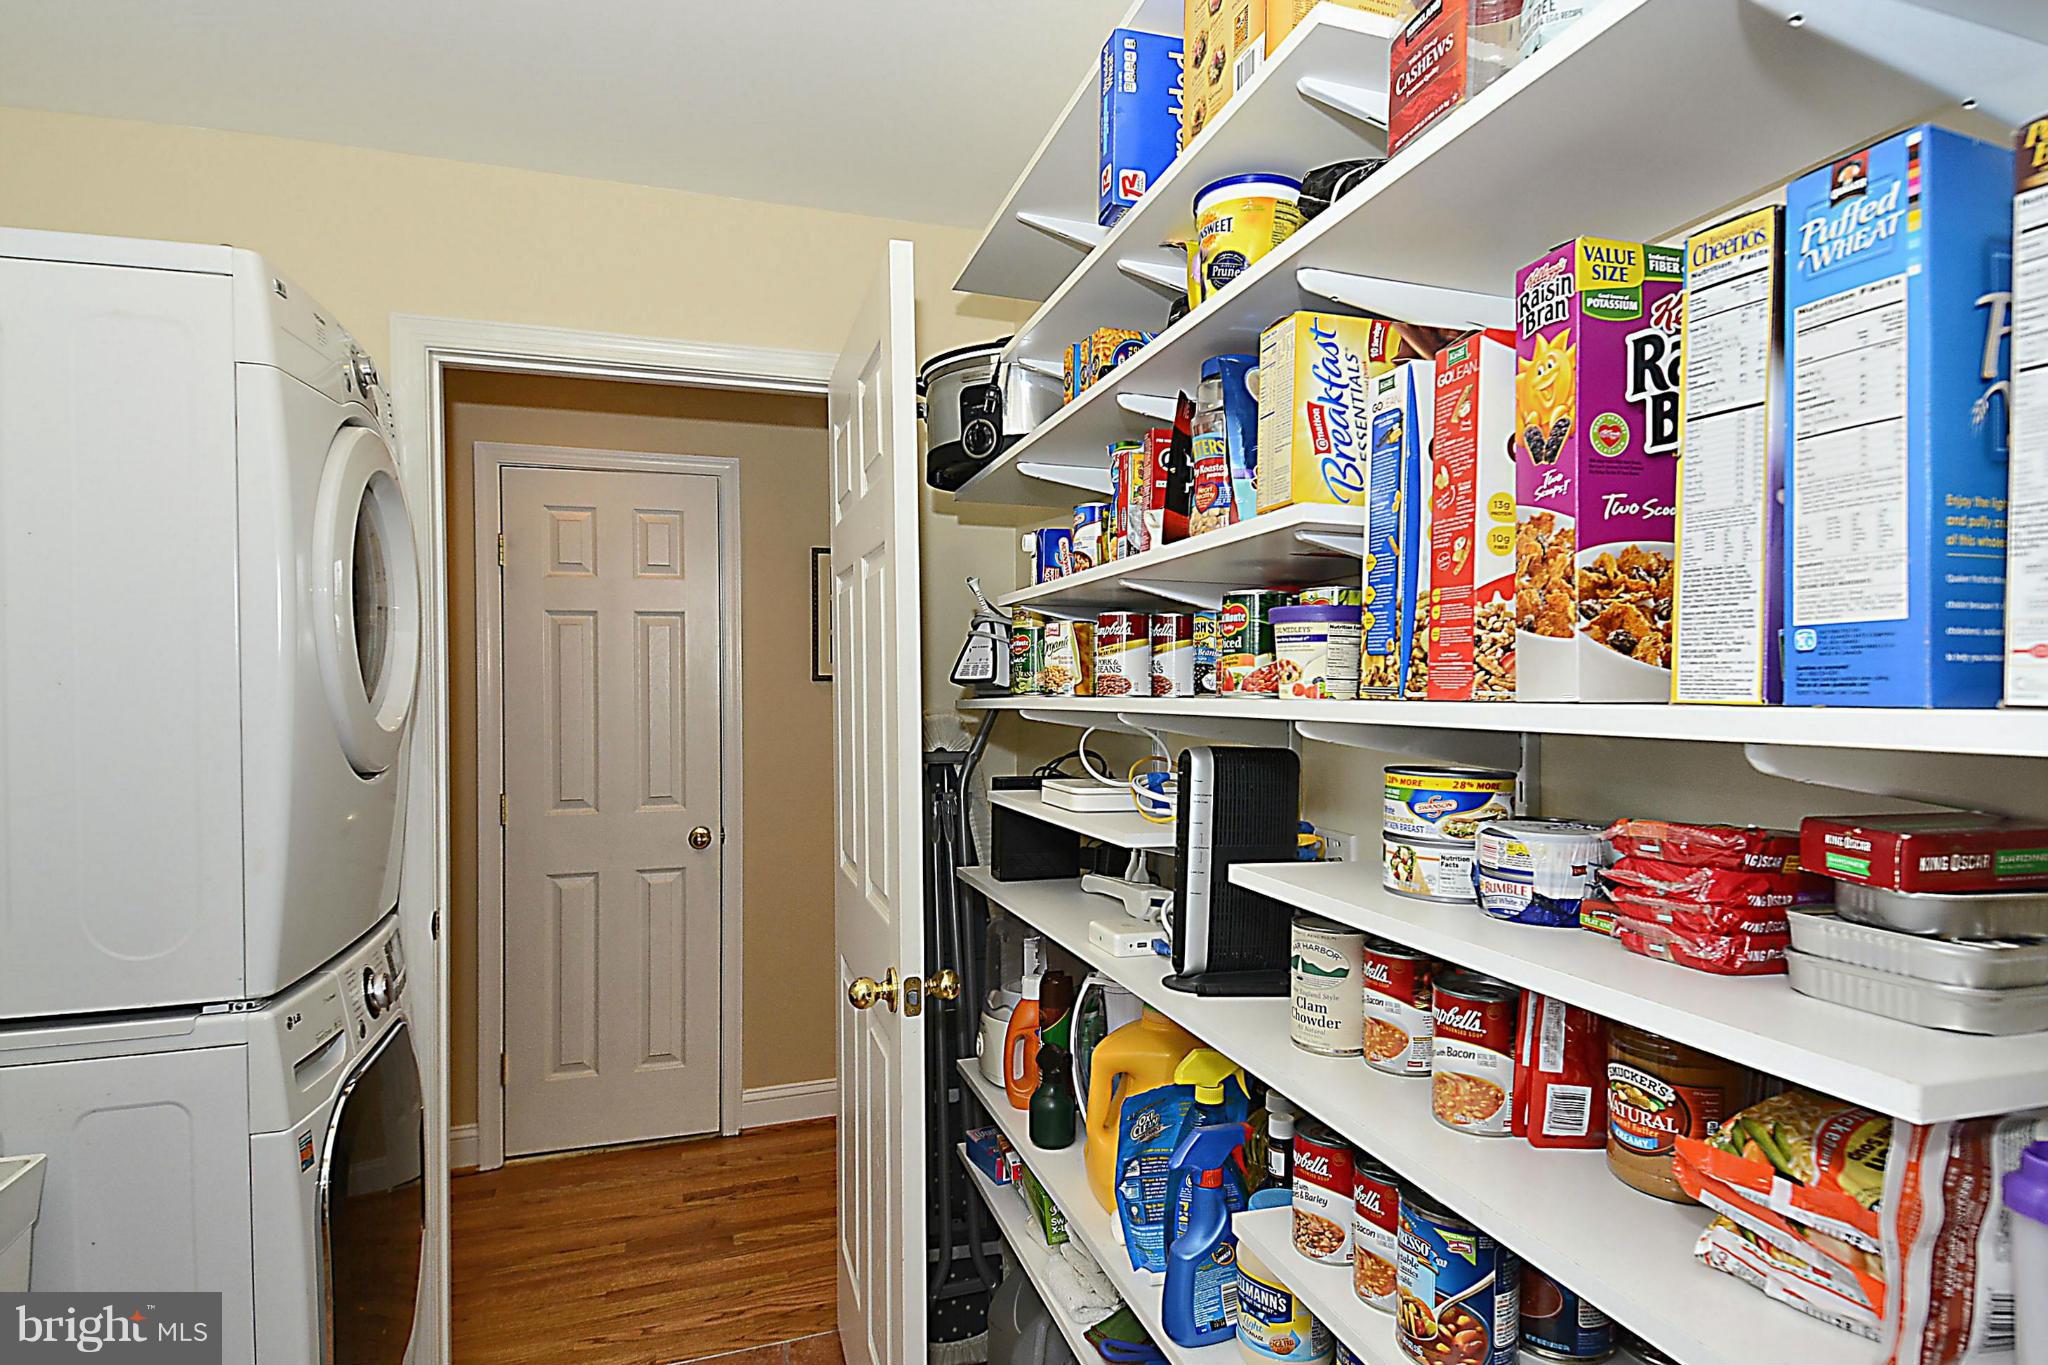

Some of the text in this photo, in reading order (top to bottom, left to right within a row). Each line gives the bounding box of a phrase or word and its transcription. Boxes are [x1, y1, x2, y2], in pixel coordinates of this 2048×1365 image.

[1395, 32, 1455, 96] CASHEWS
[1799, 181, 1902, 254] Puffed
[1692, 226, 1768, 267] Cheerios
[1797, 209, 1906, 272] WHEAT
[1584, 246, 1636, 265] VALUE
[1592, 265, 1629, 283] SIZE
[1649, 259, 1681, 274] FIBER
[1519, 275, 1573, 319] Raisin
[1586, 297, 1638, 311] POTASSIUM
[1525, 299, 1568, 336] Bran
[1309, 317, 1364, 503] Breakfast
[1345, 353, 1367, 462] ESSENTIALS
[1200, 465, 1228, 476] Roaste
[1542, 469, 1564, 488] Two
[1493, 500, 1511, 511] 13g
[1602, 494, 1638, 520] Two
[1492, 534, 1511, 545] 10g
[1283, 625, 1311, 634] MEDLEYS
[1400, 779, 1424, 787] MORE
[1452, 781, 1475, 790] 28%
[1476, 782, 1501, 791] MORE
[1400, 823, 1425, 833] BREAST
[1825, 834, 1844, 846] KING
[1440, 854, 1471, 863] Nutrition
[1919, 853, 1991, 873] KING OSCAR
[1485, 881, 1528, 897] BUMBLE
[1740, 921, 1764, 932] KING
[1302, 943, 1341, 961] HARBOR
[1296, 995, 1328, 1014] Clam
[1322, 992, 1340, 1002] Style
[1292, 1006, 1342, 1030] Chowder
[1446, 1046, 1476, 1060] Bacon
[1608, 1090, 1680, 1134] NATURAL
[1133, 1115, 1160, 1138] CLEAN
[1614, 1129, 1650, 1148] CREAMY
[1305, 1193, 1329, 1208] Barley
